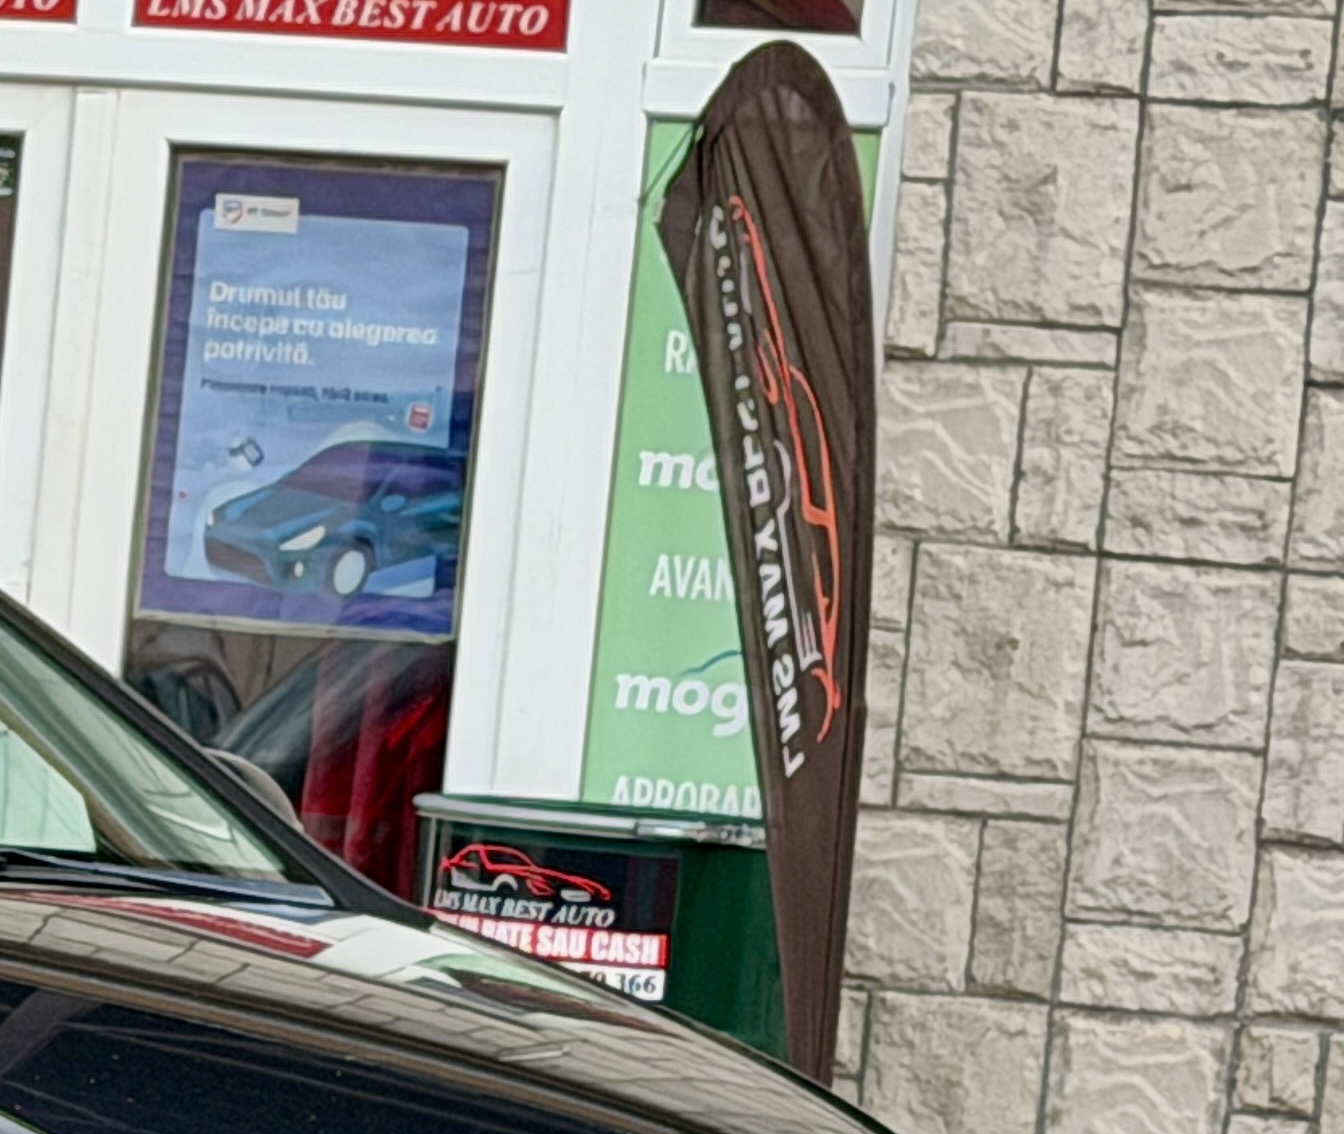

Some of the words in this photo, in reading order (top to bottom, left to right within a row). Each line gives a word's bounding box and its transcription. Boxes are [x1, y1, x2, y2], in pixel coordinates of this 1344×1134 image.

[147, 0, 227, 20] LMS
[234, 0, 322, 24] MAX
[331, 0, 438, 30] BEST
[434, 2, 549, 36] AUTO
[209, 280, 301, 309] Drumul
[292, 318, 324, 339] cu
[501, 899, 554, 922] BEST
[551, 904, 616, 928] AUTO
[536, 925, 588, 960] SAU
[590, 930, 660, 966] CASH
